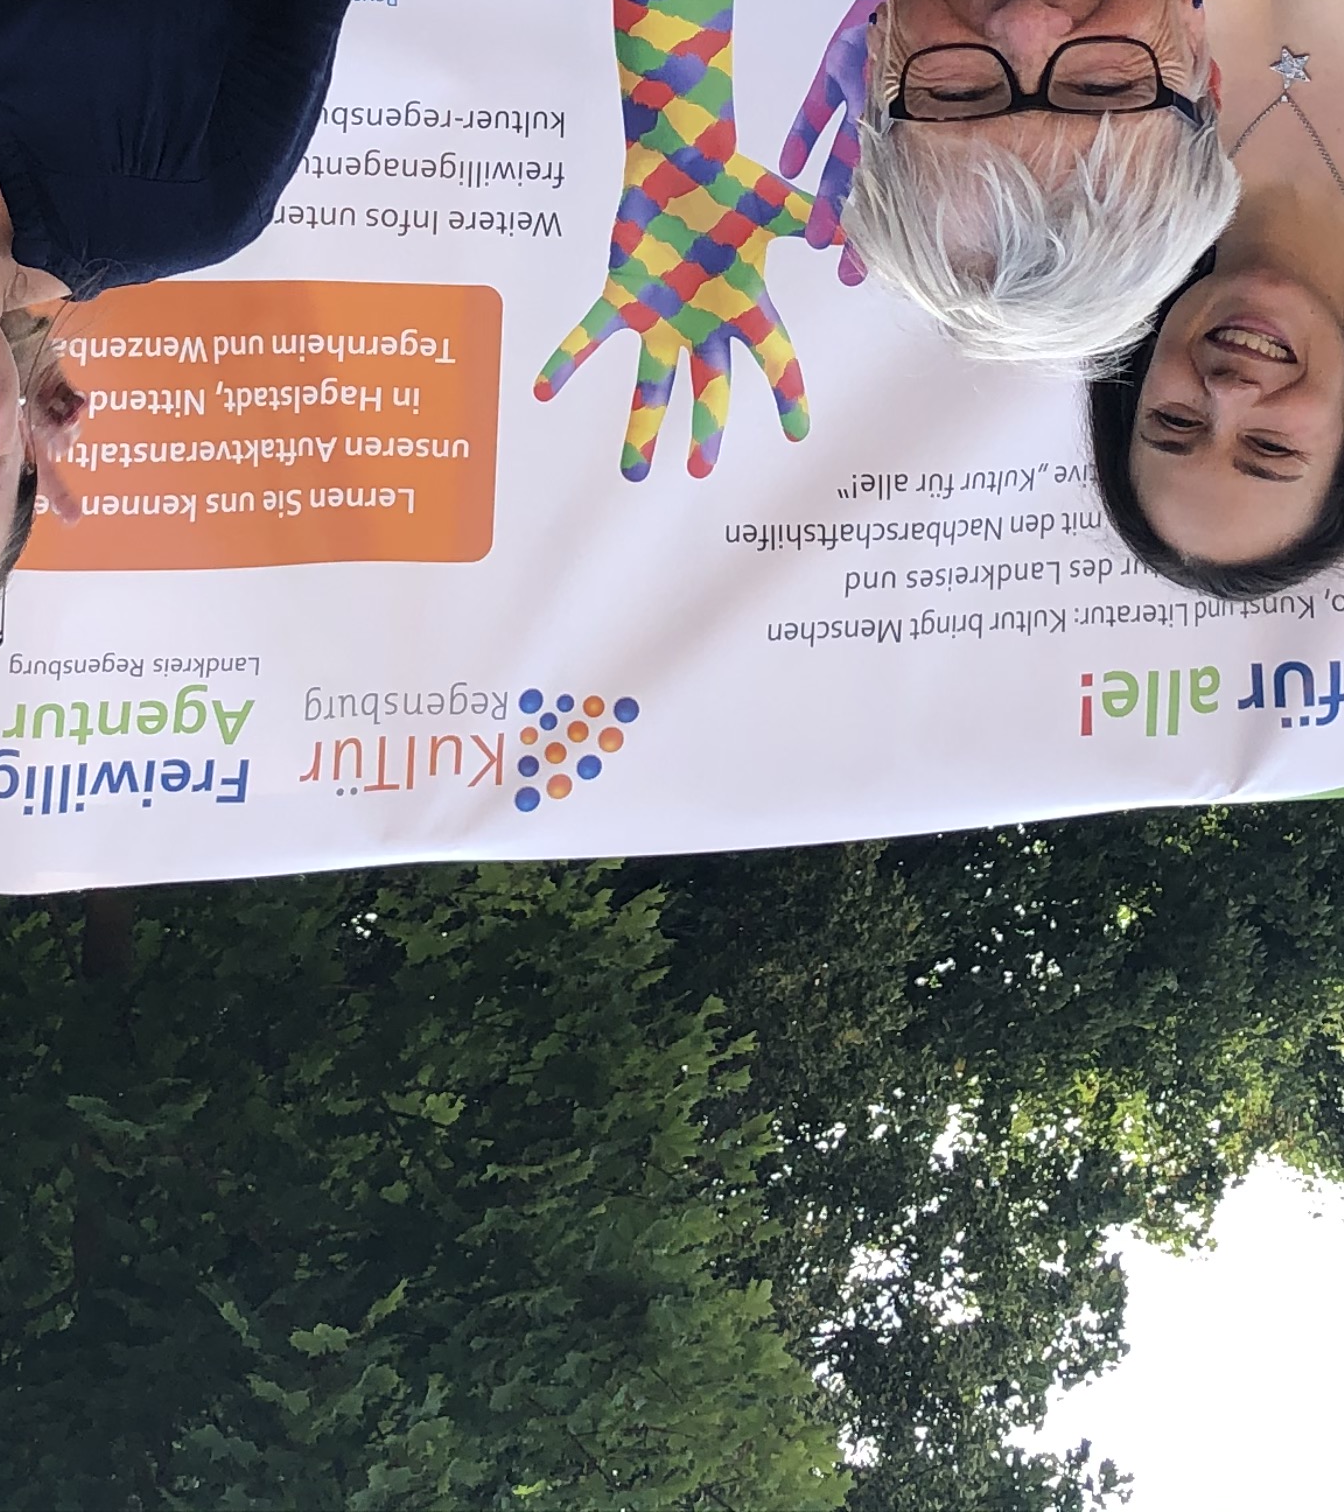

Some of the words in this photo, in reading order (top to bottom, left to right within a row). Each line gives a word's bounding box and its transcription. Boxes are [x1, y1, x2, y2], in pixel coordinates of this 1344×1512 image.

[296, 149, 565, 189] freiwilligenagentu
[274, 206, 355, 230] unter
[365, 208, 437, 236] Infos
[448, 211, 562, 237] Weitere
[51, 336, 207, 366] Wenzenba
[214, 336, 263, 363] und
[272, 329, 455, 364] Tegernheim
[88, 389, 205, 419] Nittend
[216, 378, 382, 415] Hagelstadt,
[393, 387, 420, 415] in
[345, 437, 470, 463] unseren
[310, 487, 414, 513] Lernen
[916, 472, 954, 500] für
[82, 494, 197, 522] kennen
[206, 491, 254, 515] uns
[263, 489, 302, 518] Sie
[725, 516, 1002, 550] Nachbarschaftshilfen
[1010, 513, 1055, 539] den
[1062, 512, 1101, 536] mit
[845, 571, 896, 597] und
[906, 560, 1060, 593] Landkreises
[1070, 558, 1112, 582] des
[1074, 603, 1187, 628] Literatur:
[1195, 600, 1233, 627] und
[1240, 595, 1314, 619] Kunst
[767, 619, 902, 647] Menschen
[910, 609, 982, 640] bringt
[990, 608, 1066, 636] Kultur
[9, 653, 144, 681] Regensburg
[152, 654, 261, 679] Landkreis
[304, 683, 509, 725] Regensburg
[1080, 666, 1220, 736] alle!
[3, 685, 254, 746] Agentur
[299, 733, 504, 796] KulTür
